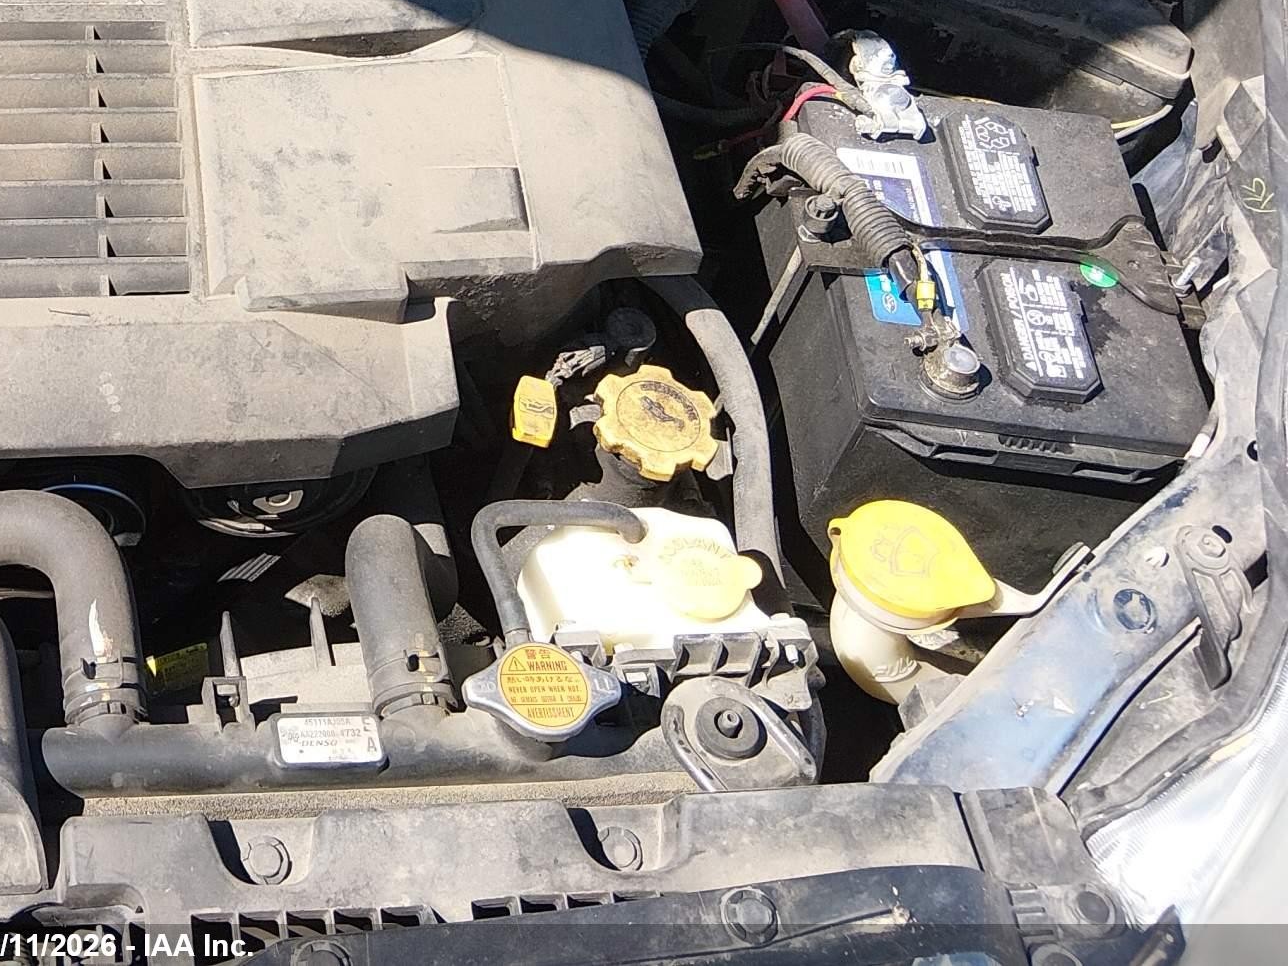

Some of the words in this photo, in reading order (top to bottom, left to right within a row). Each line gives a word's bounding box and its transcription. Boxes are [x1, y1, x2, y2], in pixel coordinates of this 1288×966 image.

[1000, 273, 1019, 309] POISON
[1013, 319, 1034, 360] DANGER
[526, 660, 568, 671] WARNING
[875, 656, 914, 677] FULL
[509, 685, 527, 693] NEVER
[530, 685, 546, 693] OPEN
[302, 739, 338, 747] DENSO
[367, 737, 377, 752] A
